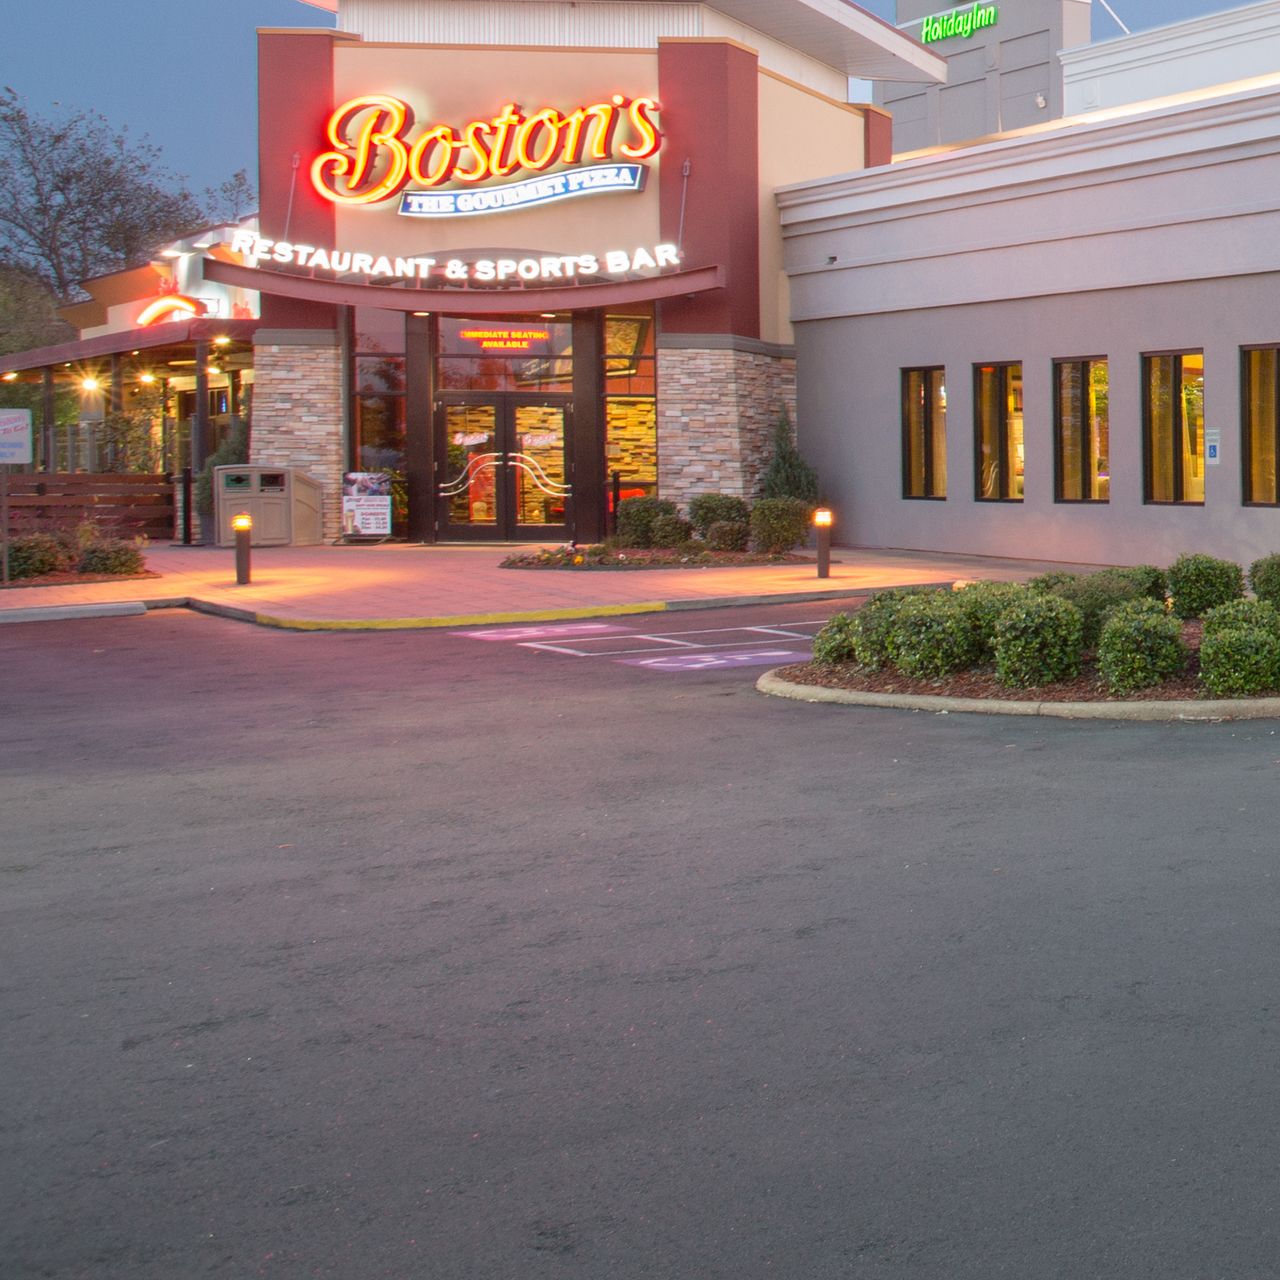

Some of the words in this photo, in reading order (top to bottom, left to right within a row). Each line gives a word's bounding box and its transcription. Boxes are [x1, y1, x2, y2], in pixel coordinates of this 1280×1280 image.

[921, 9, 972, 44] Holiday
[973, 2, 996, 29] Inn
[310, 93, 663, 206] Boston's
[407, 194, 455, 213] THE
[457, 175, 566, 212] GOURMET
[568, 167, 635, 194] PIZZA
[231, 228, 436, 279] RESTAURANT
[445, 259, 470, 280] &
[476, 254, 599, 281] SPORTS
[605, 243, 681, 274] BAR
[481, 340, 529, 349] AVAILABLE
